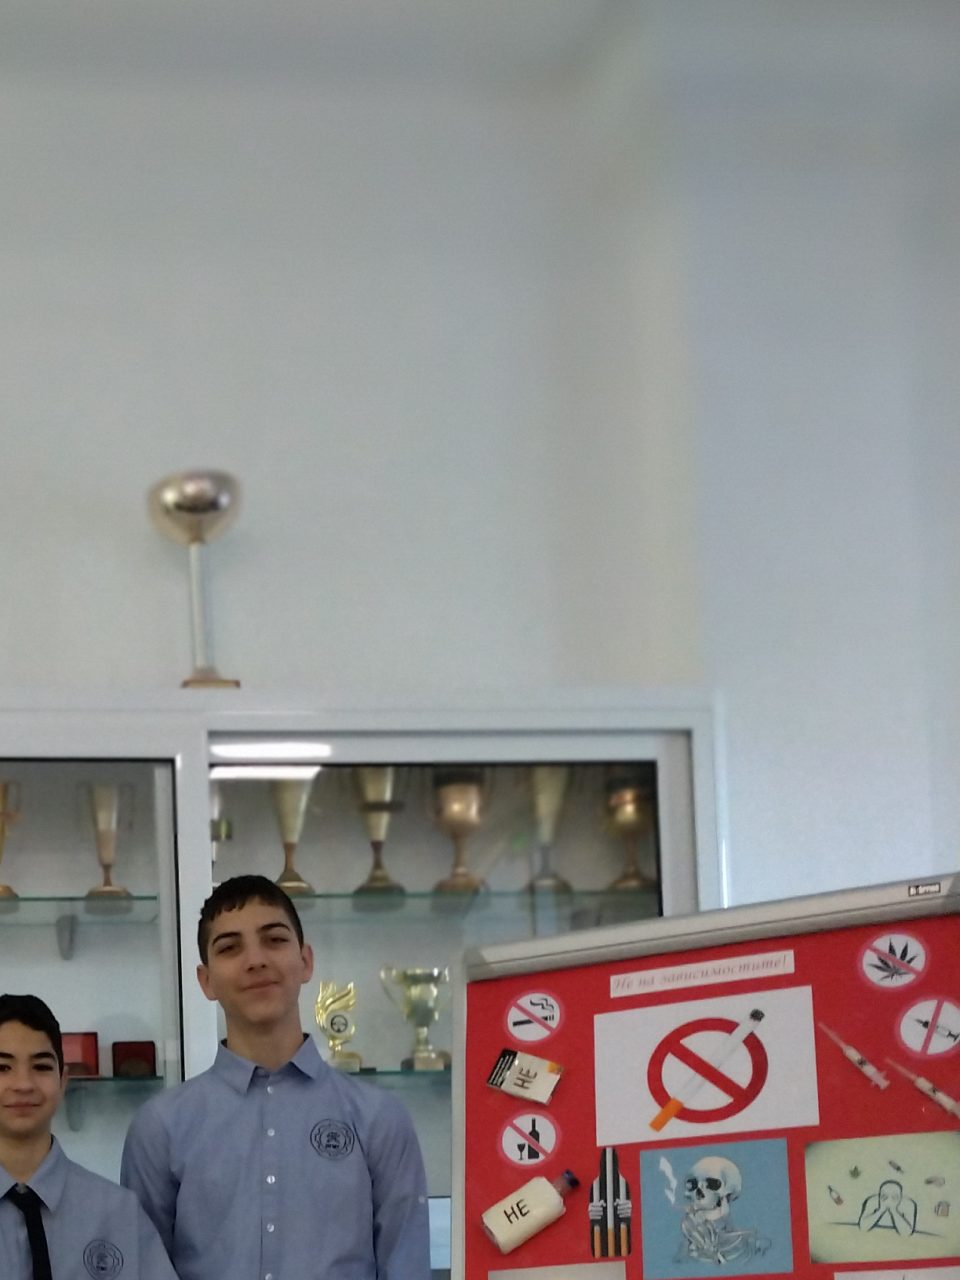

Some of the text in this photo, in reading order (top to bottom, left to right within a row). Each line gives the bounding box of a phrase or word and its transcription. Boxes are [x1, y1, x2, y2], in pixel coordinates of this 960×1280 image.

[615, 977, 632, 990] Не
[513, 1067, 538, 1090] НЕ
[503, 1199, 530, 1225] НЕ
